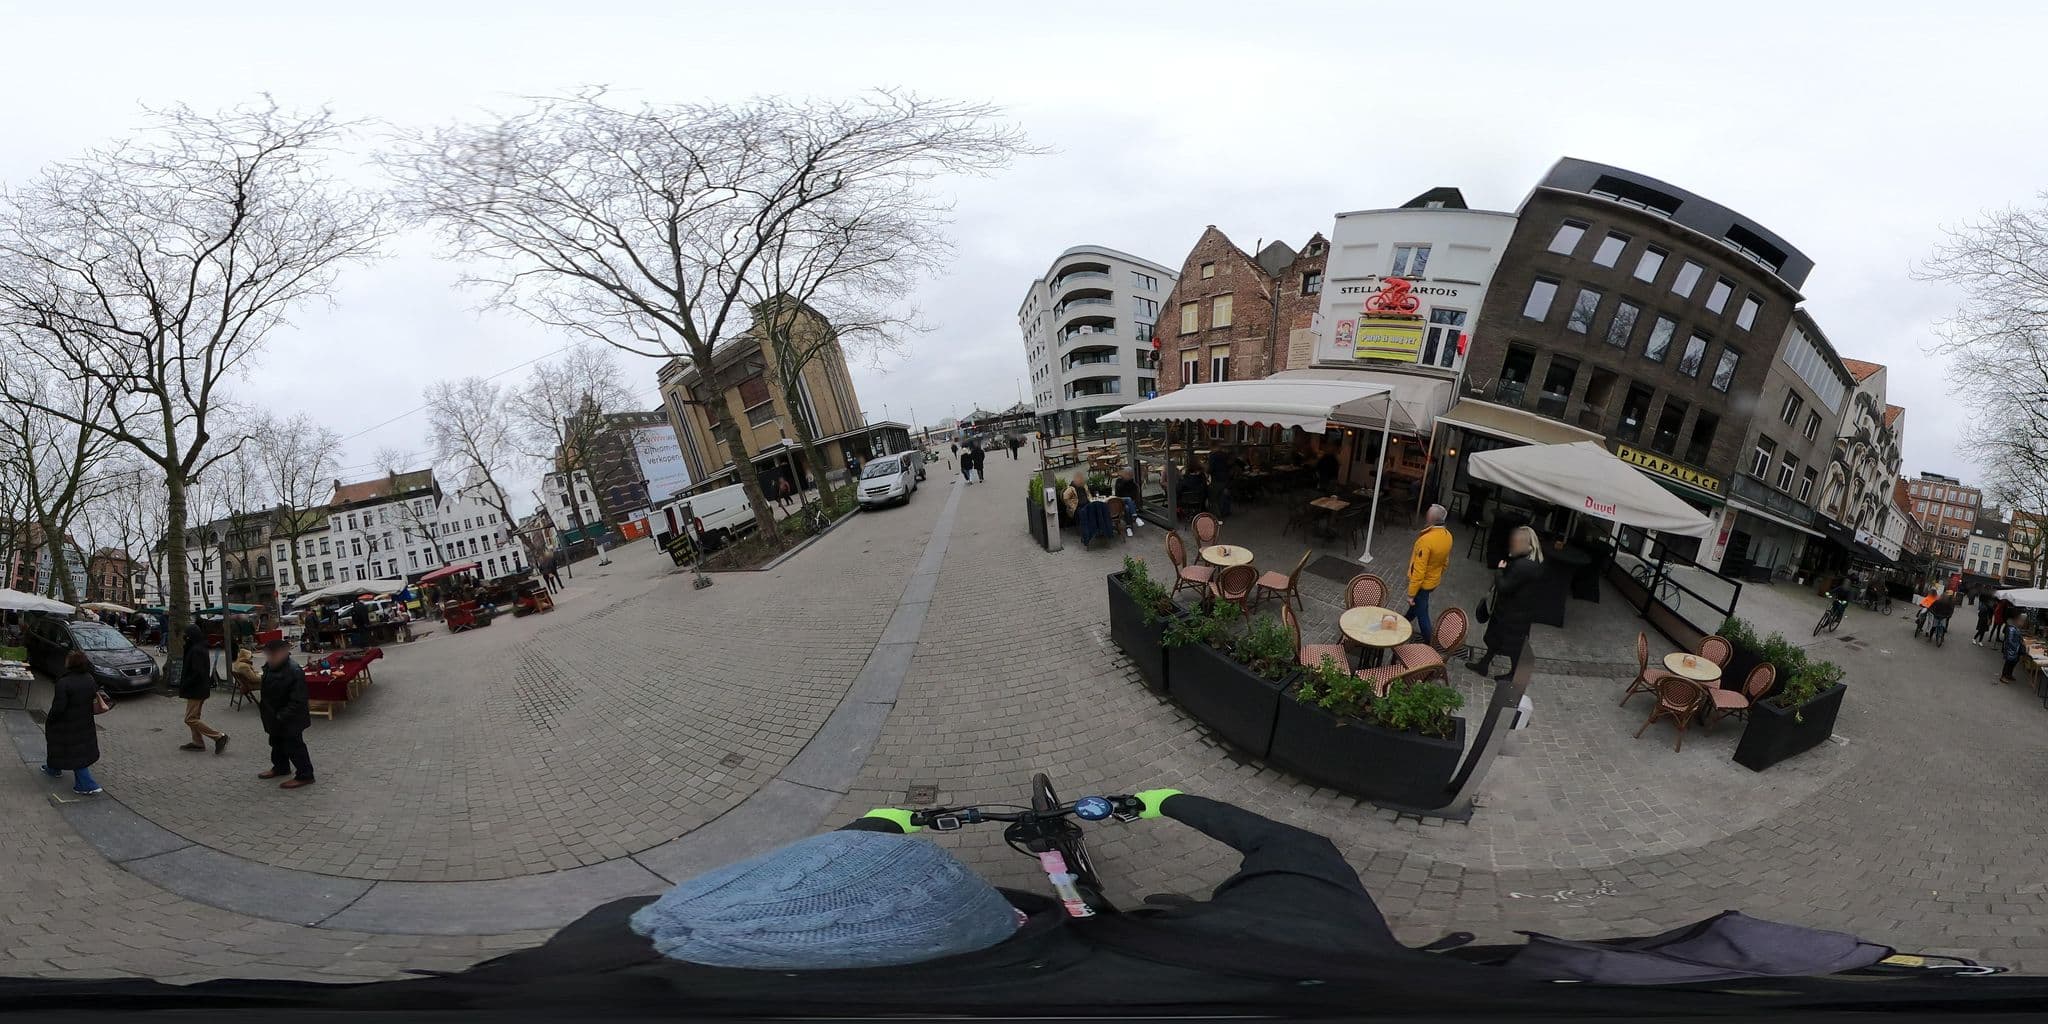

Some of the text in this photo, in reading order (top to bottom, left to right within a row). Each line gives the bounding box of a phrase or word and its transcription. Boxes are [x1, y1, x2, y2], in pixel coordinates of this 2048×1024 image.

[1340, 285, 1458, 297] STELLA ARTOIS
[1620, 449, 1718, 490] PITAPALACE
[1585, 495, 1617, 516] Duvel
